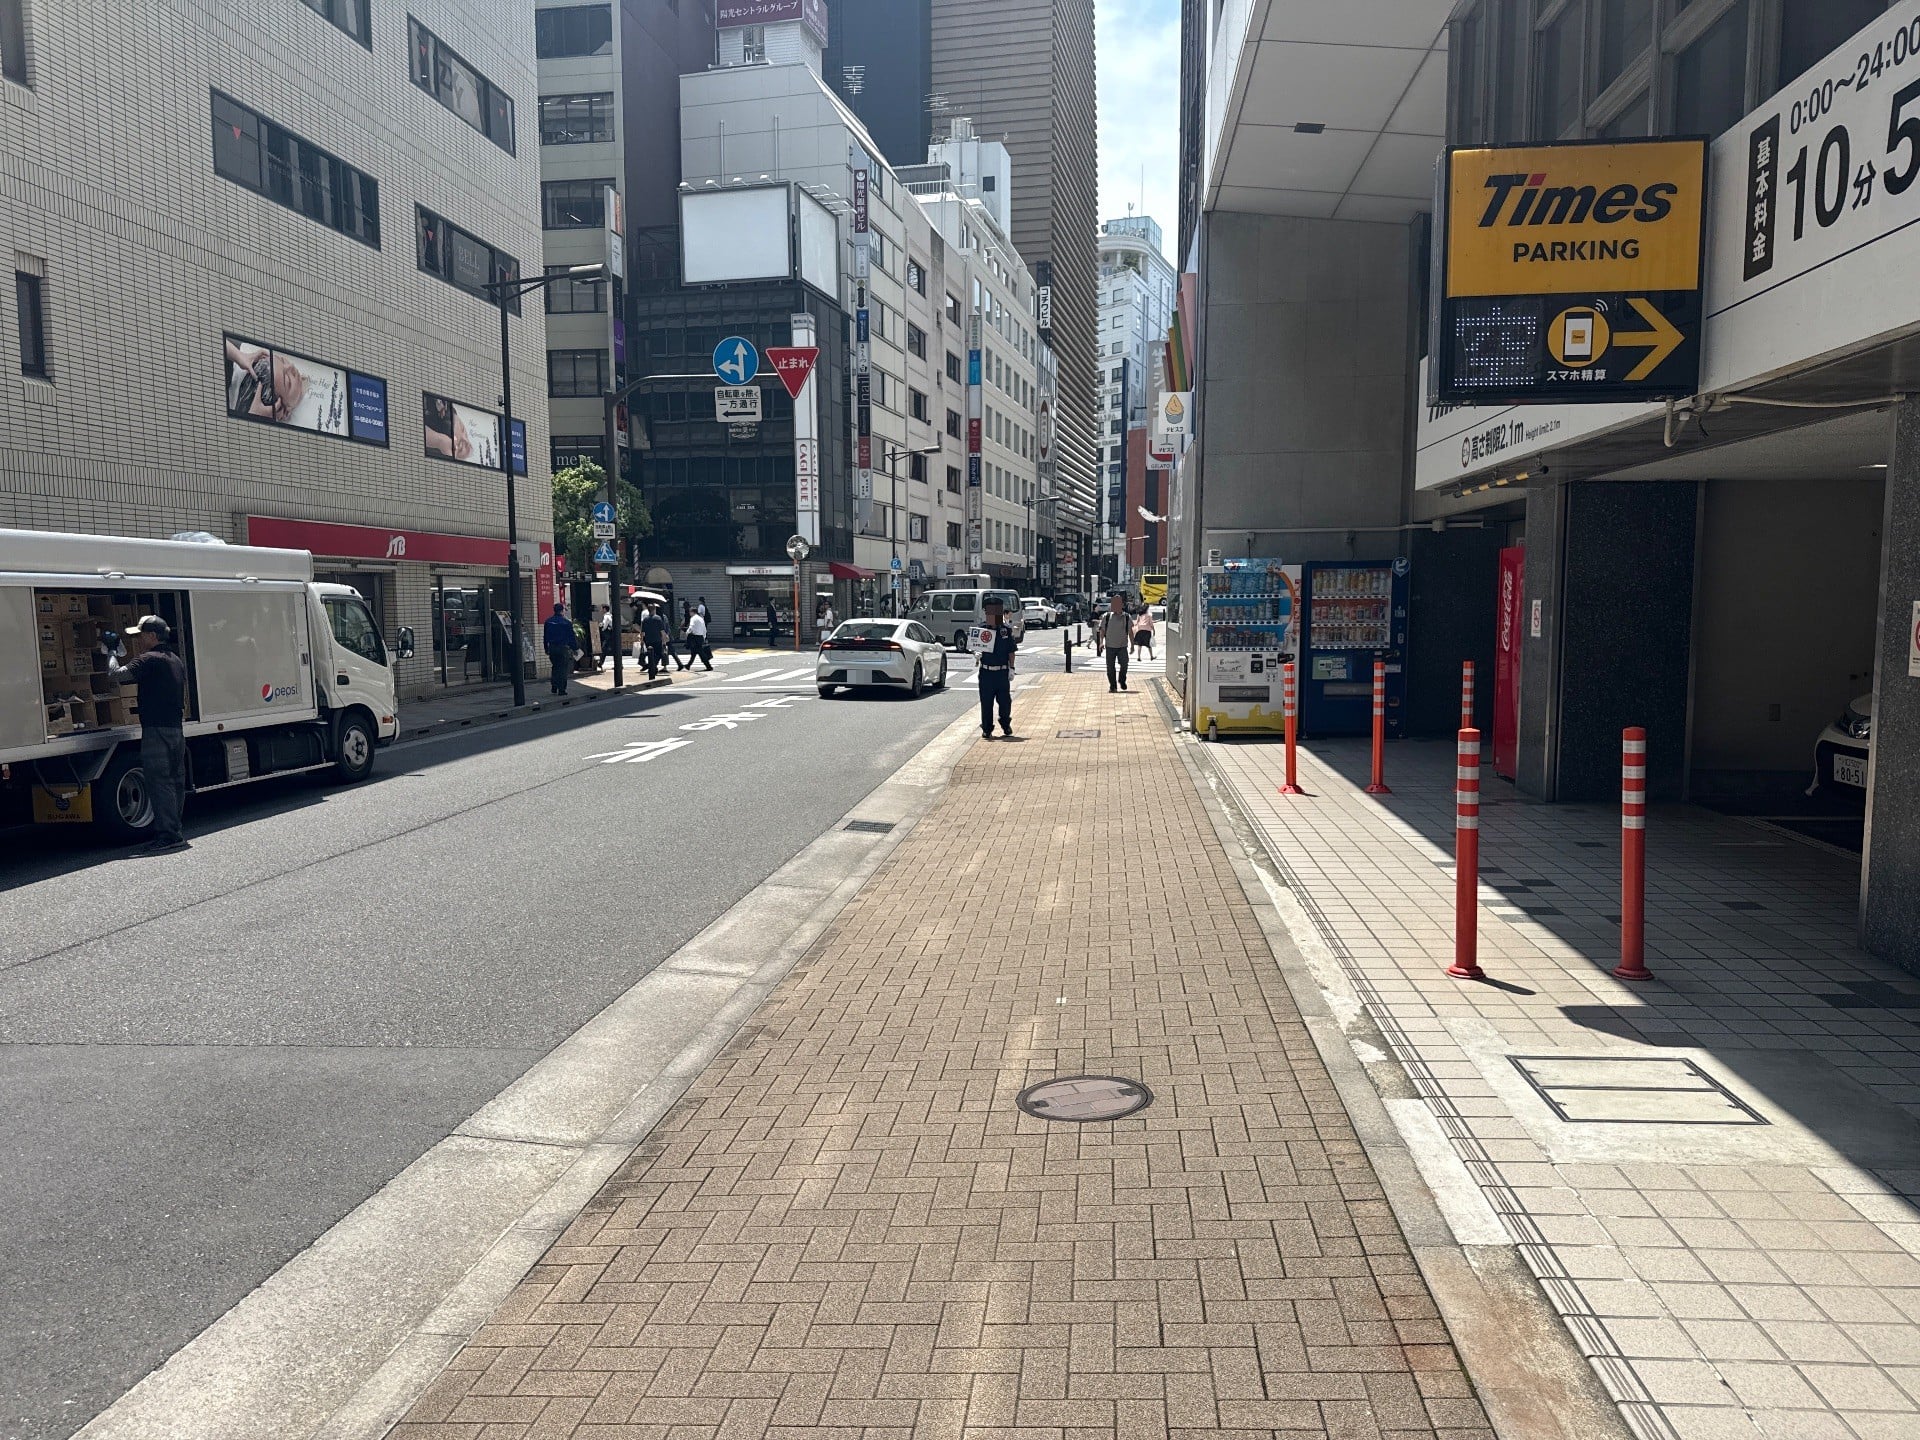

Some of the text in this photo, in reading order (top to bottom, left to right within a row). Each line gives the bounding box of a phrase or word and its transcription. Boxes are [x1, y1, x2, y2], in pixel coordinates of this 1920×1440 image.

[1478, 173, 1678, 228] Times
[1751, 136, 1772, 263] 基本料金
[1513, 239, 1639, 263] PARKING
[1455, 306, 1537, 387] 空
[778, 357, 809, 369] 止まれ
[1547, 368, 1607, 382] スマホ精算
[717, 389, 759, 399] 自転車を除く
[720, 400, 758, 408] 一方通行
[386, 535, 406, 558] JTB
[274, 683, 298, 699] pepsi
